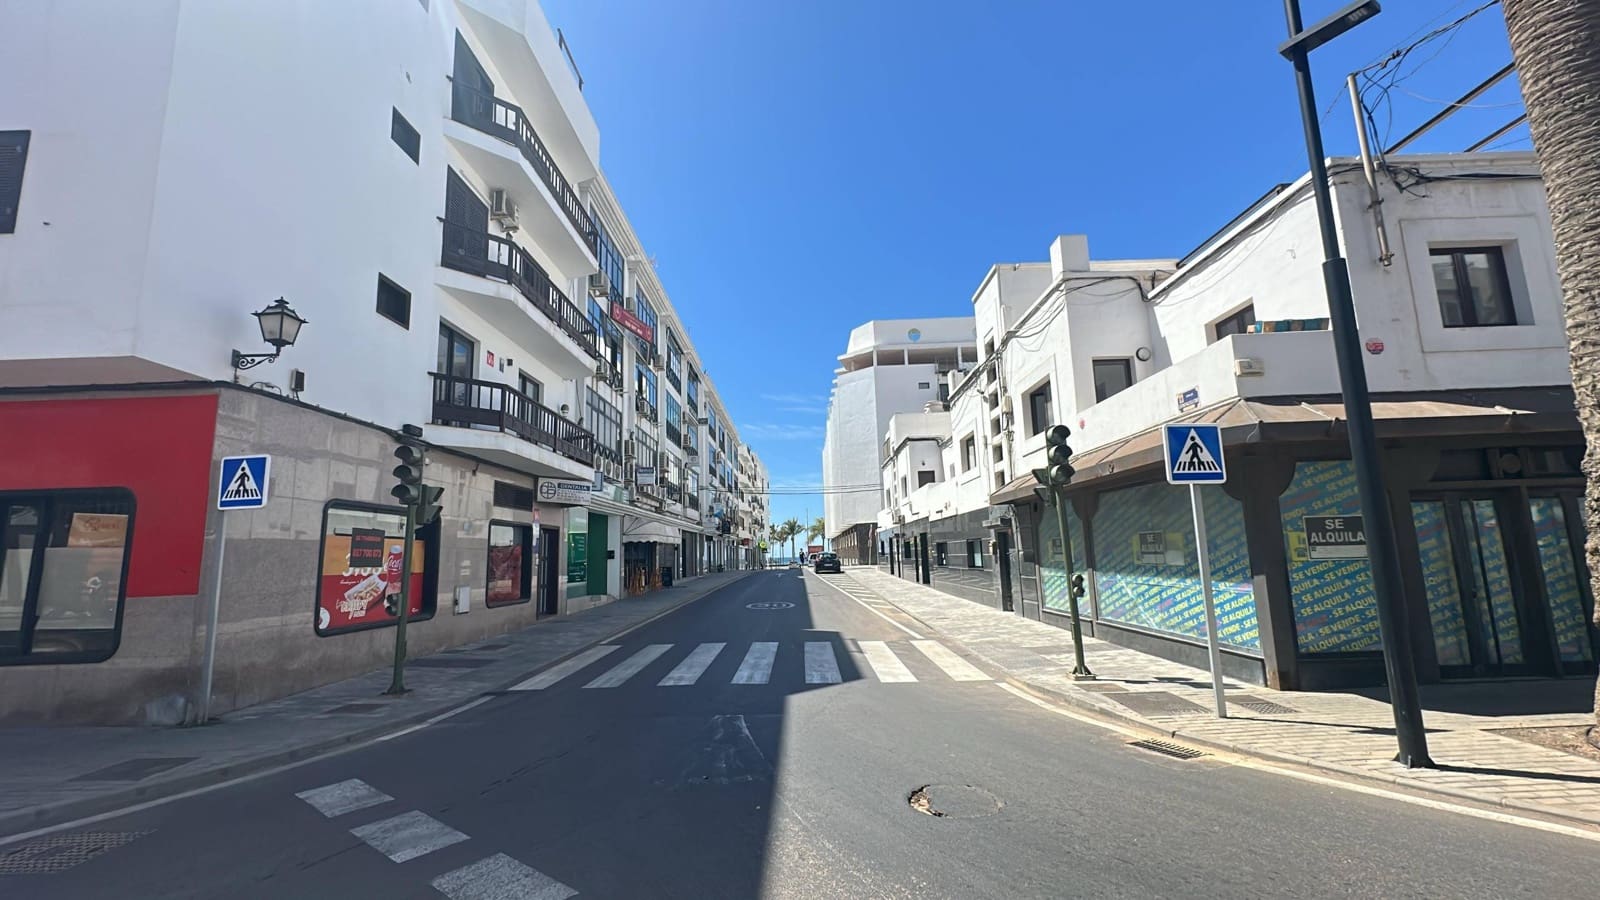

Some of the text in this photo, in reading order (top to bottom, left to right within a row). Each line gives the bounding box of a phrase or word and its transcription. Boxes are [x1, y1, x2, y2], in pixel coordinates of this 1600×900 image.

[560, 483, 588, 491] DENTALIA
[1325, 519, 1345, 530] SE
[1311, 531, 1366, 542] ALQUILA
[1292, 571, 1305, 581] SE
[1304, 560, 1336, 577] VENDE
[1324, 571, 1336, 582] SE
[1302, 593, 1314, 603] SE
[1313, 578, 1352, 599] ALQUILA
[1300, 606, 1314, 617] SE
[1313, 592, 1351, 612] ALQUILA
[1332, 607, 1346, 618] SE
[1318, 625, 1332, 637] SE
[1331, 614, 1362, 632] VENDE
